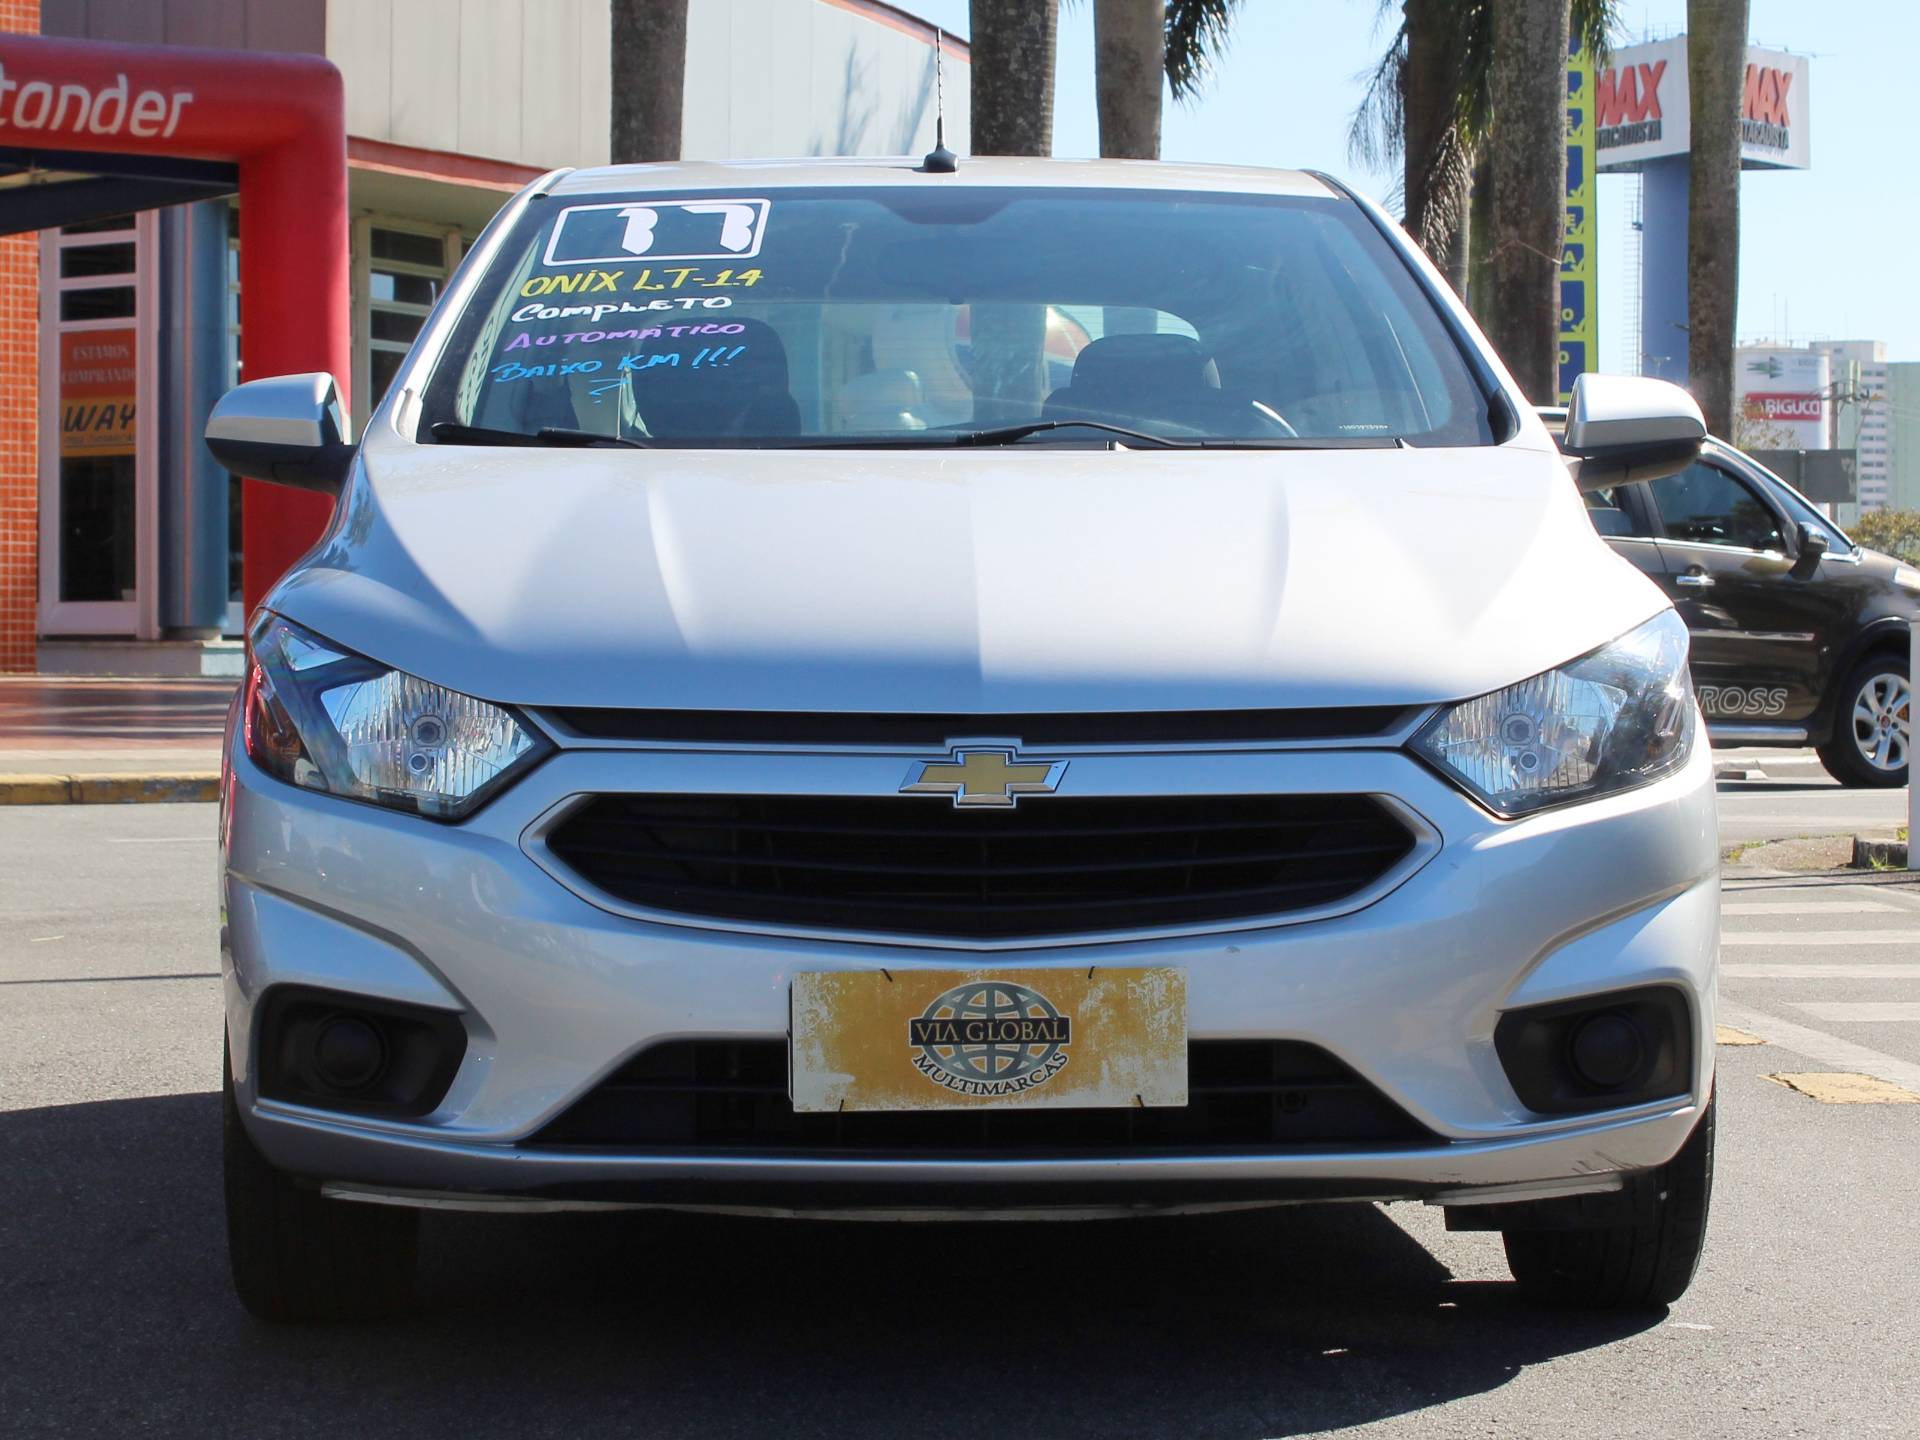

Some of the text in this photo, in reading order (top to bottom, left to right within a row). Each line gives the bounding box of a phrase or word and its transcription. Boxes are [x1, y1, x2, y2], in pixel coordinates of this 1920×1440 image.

[63, 403, 136, 432] WAY
[914, 1020, 1066, 1042] VIA GLOBAL
[912, 1052, 1069, 1096] MULTIMARCAS
